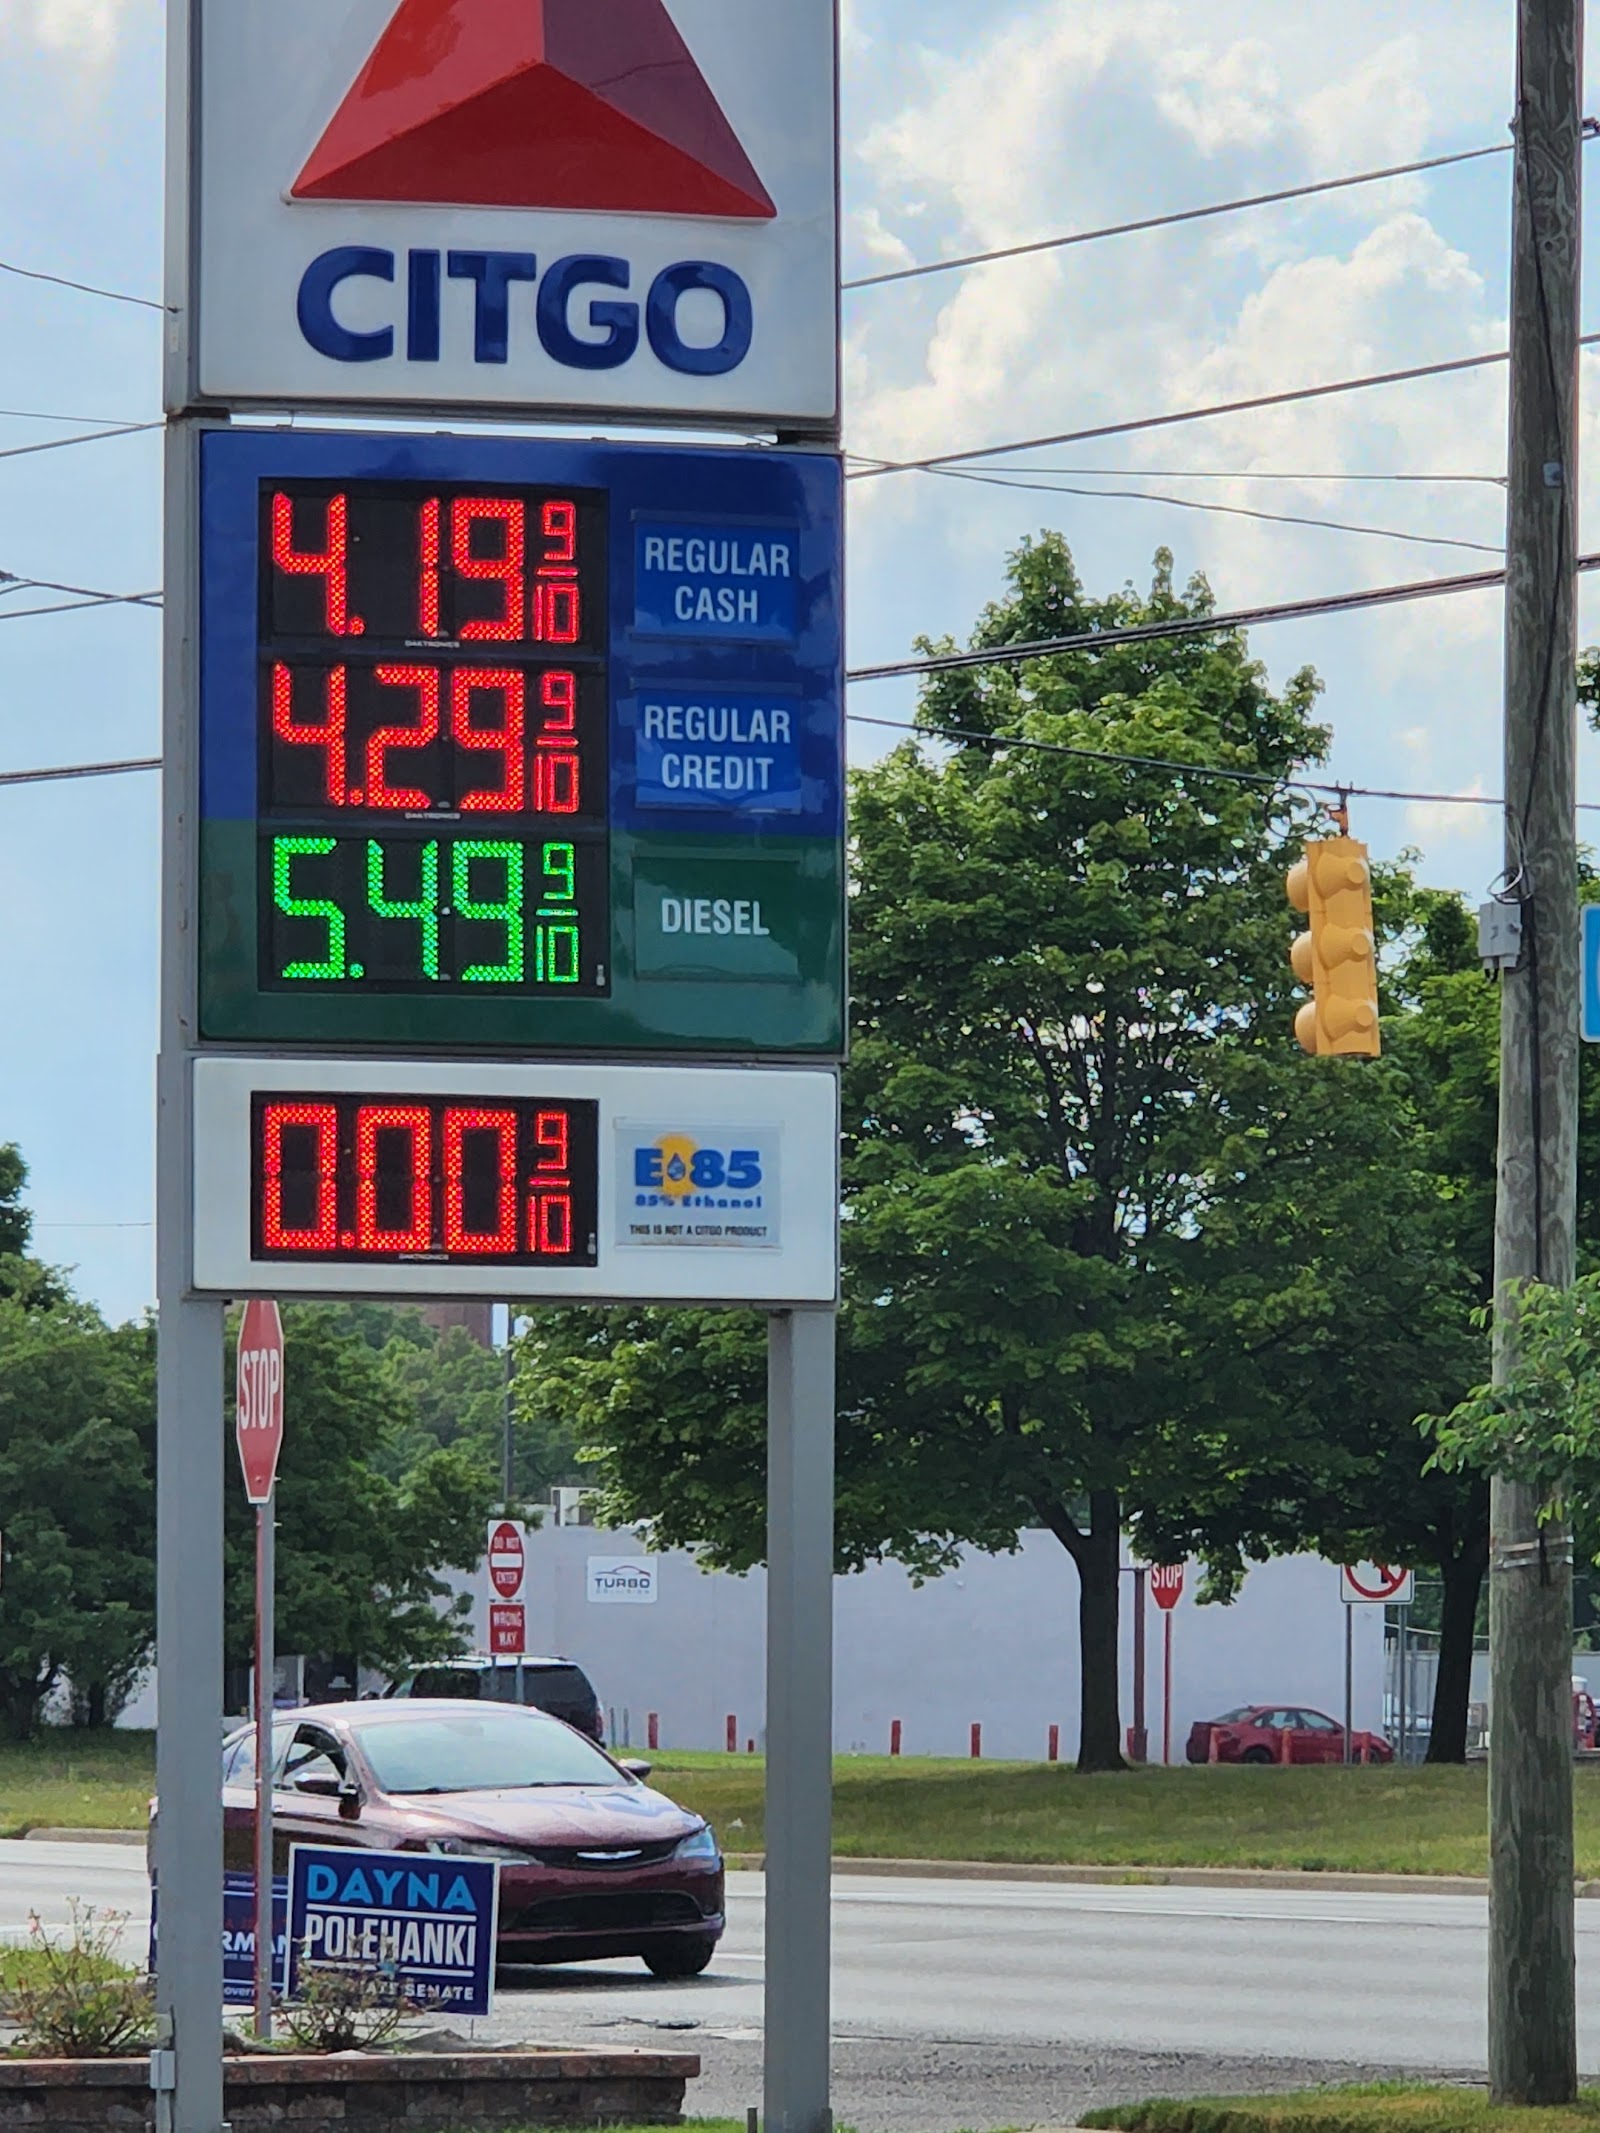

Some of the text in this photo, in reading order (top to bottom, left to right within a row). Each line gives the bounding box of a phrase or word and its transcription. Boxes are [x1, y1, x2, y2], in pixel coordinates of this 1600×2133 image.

[297, 245, 752, 376] CITGO
[272, 491, 524, 641] 4.19
[645, 537, 790, 578] REGULAR
[674, 585, 758, 624] CASH
[272, 663, 524, 811] 4.29
[644, 705, 790, 744] REGULAR
[661, 753, 773, 791] CREDIT
[273, 836, 524, 982] 5.49
[661, 898, 770, 936] DIESEL
[263, 1103, 517, 1252] 0.00
[635, 1194, 762, 1208] 85% Ethanol
[629, 1224, 767, 1236] THIS IS NOT A CITGO PRODUCT
[240, 1348, 279, 1430] STOP
[594, 1578, 650, 1588] TURBO
[1152, 1562, 1182, 1588] STOP
[493, 1611, 522, 1627] WRONG
[499, 1632, 517, 1646] WAY
[307, 1864, 477, 1911] DAYNA
[306, 1913, 477, 1967] POLEHANKI
[405, 1983, 474, 2000] SENATE
